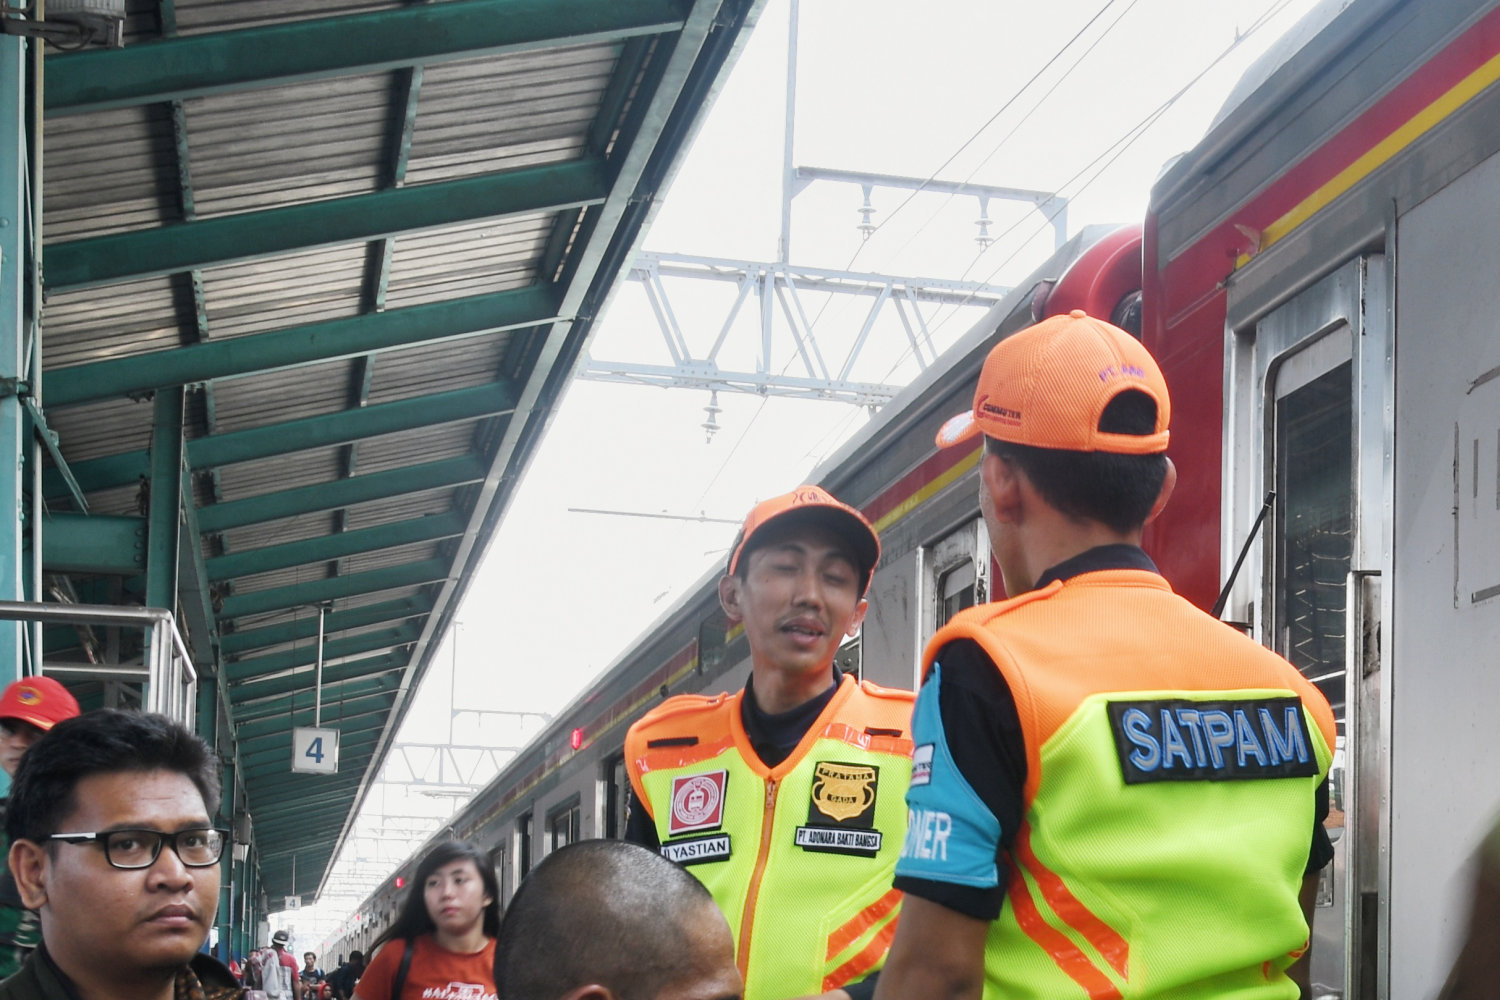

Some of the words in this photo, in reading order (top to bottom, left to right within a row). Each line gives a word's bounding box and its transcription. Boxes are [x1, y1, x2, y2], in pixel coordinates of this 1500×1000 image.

[1122, 706, 1310, 772] SATPAM
[306, 737, 324, 763] 4
[822, 768, 870, 780] PRATAMA
[798, 830, 808, 844] PT.
[809, 831, 836, 845] ADONARA
[837, 833, 855, 846] BAKTI
[673, 840, 726, 858] YASTIAN
